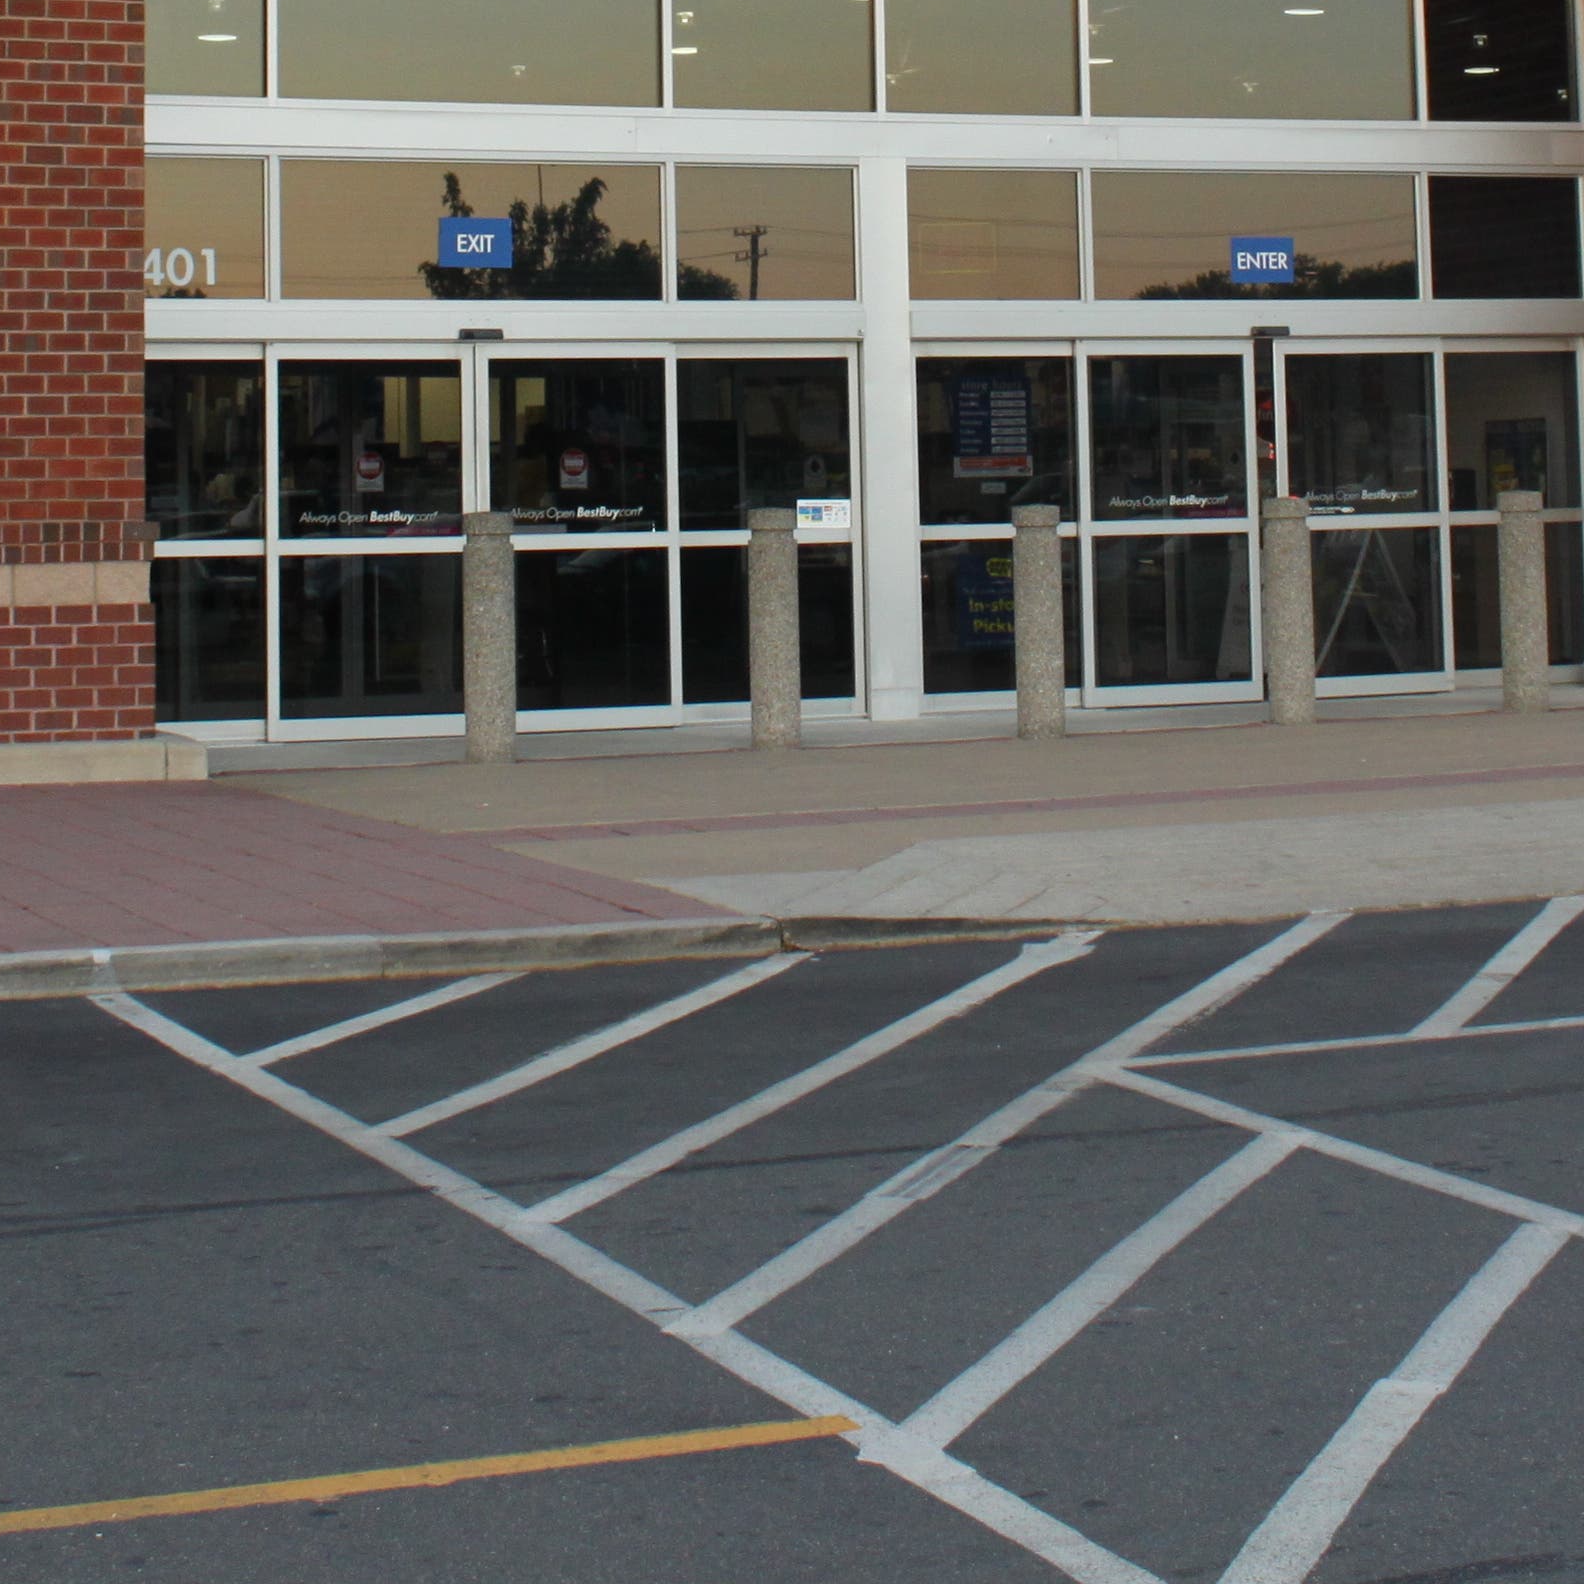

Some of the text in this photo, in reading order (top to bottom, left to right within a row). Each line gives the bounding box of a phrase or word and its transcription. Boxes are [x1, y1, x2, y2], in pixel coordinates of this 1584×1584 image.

[457, 234, 495, 253] EXIT
[1237, 252, 1288, 270] ENTER
[1109, 495, 1142, 509] Always
[1143, 495, 1167, 508] Open
[299, 510, 336, 526] Always
[338, 510, 368, 526] Open
[510, 507, 545, 521] Always
[546, 506, 575, 522] Open
[969, 597, 1014, 613] In-sto
[973, 617, 1014, 633] Picku
